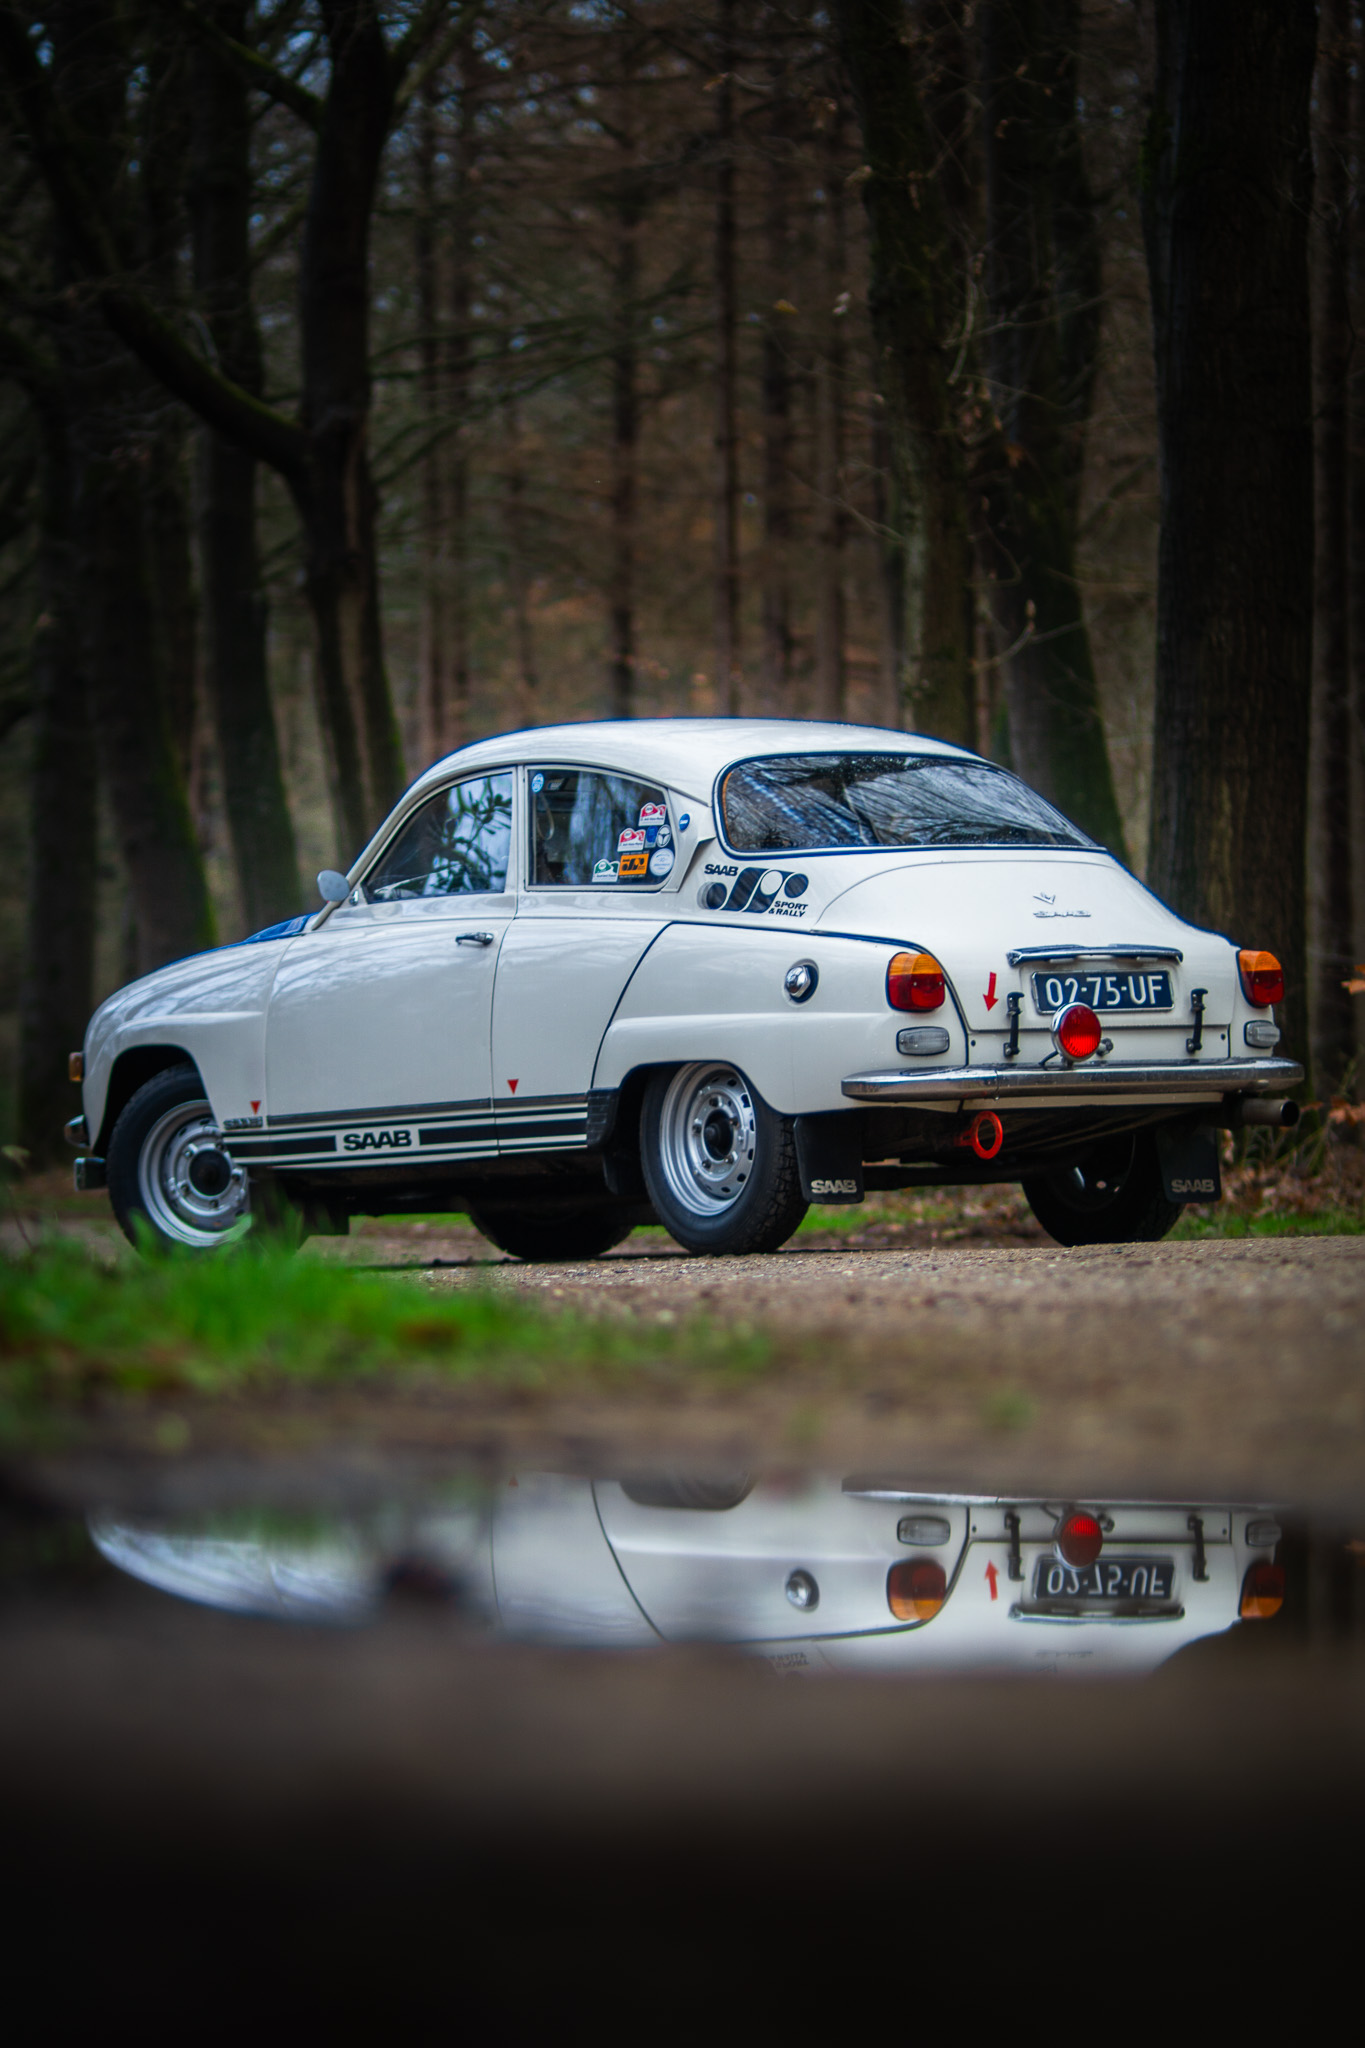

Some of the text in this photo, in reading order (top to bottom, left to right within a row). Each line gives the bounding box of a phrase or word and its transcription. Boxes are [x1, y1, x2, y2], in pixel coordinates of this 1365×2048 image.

[704, 864, 738, 876] SAAB
[774, 901, 808, 910] SPORT
[1045, 975, 1163, 1007] 02-75-UF
[343, 1130, 412, 1151] SAAB
[811, 1179, 857, 1194] SAAB
[1171, 1179, 1215, 1193] SAAB
